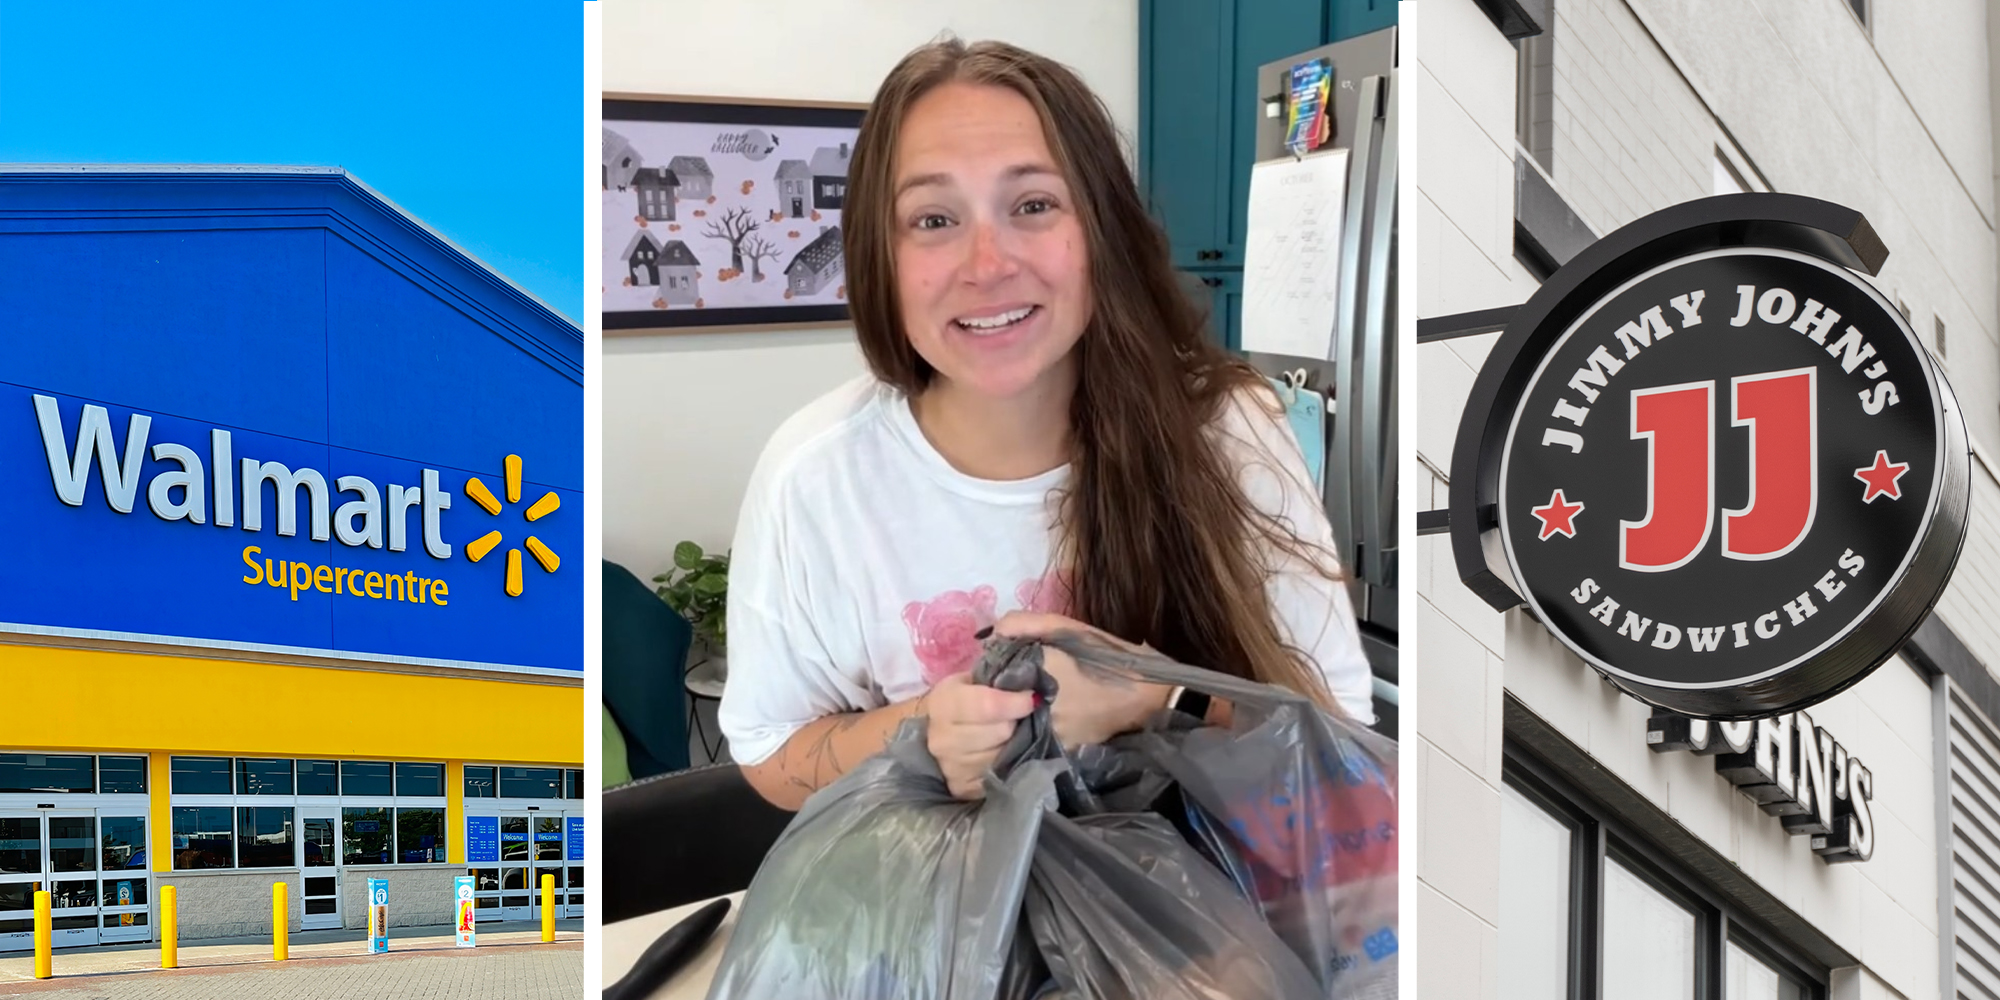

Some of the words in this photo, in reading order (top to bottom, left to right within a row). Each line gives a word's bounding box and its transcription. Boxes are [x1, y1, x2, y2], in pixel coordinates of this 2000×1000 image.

[1541, 290, 1705, 454] JIMMY
[1729, 284, 1900, 416] JOHN'S
[32, 394, 452, 559] Walmart
[1618, 366, 1818, 573] JJ
[243, 545, 449, 606] Supercentre
[1570, 547, 1866, 653] SANDWICHES
[503, 833, 524, 841] Welcome
